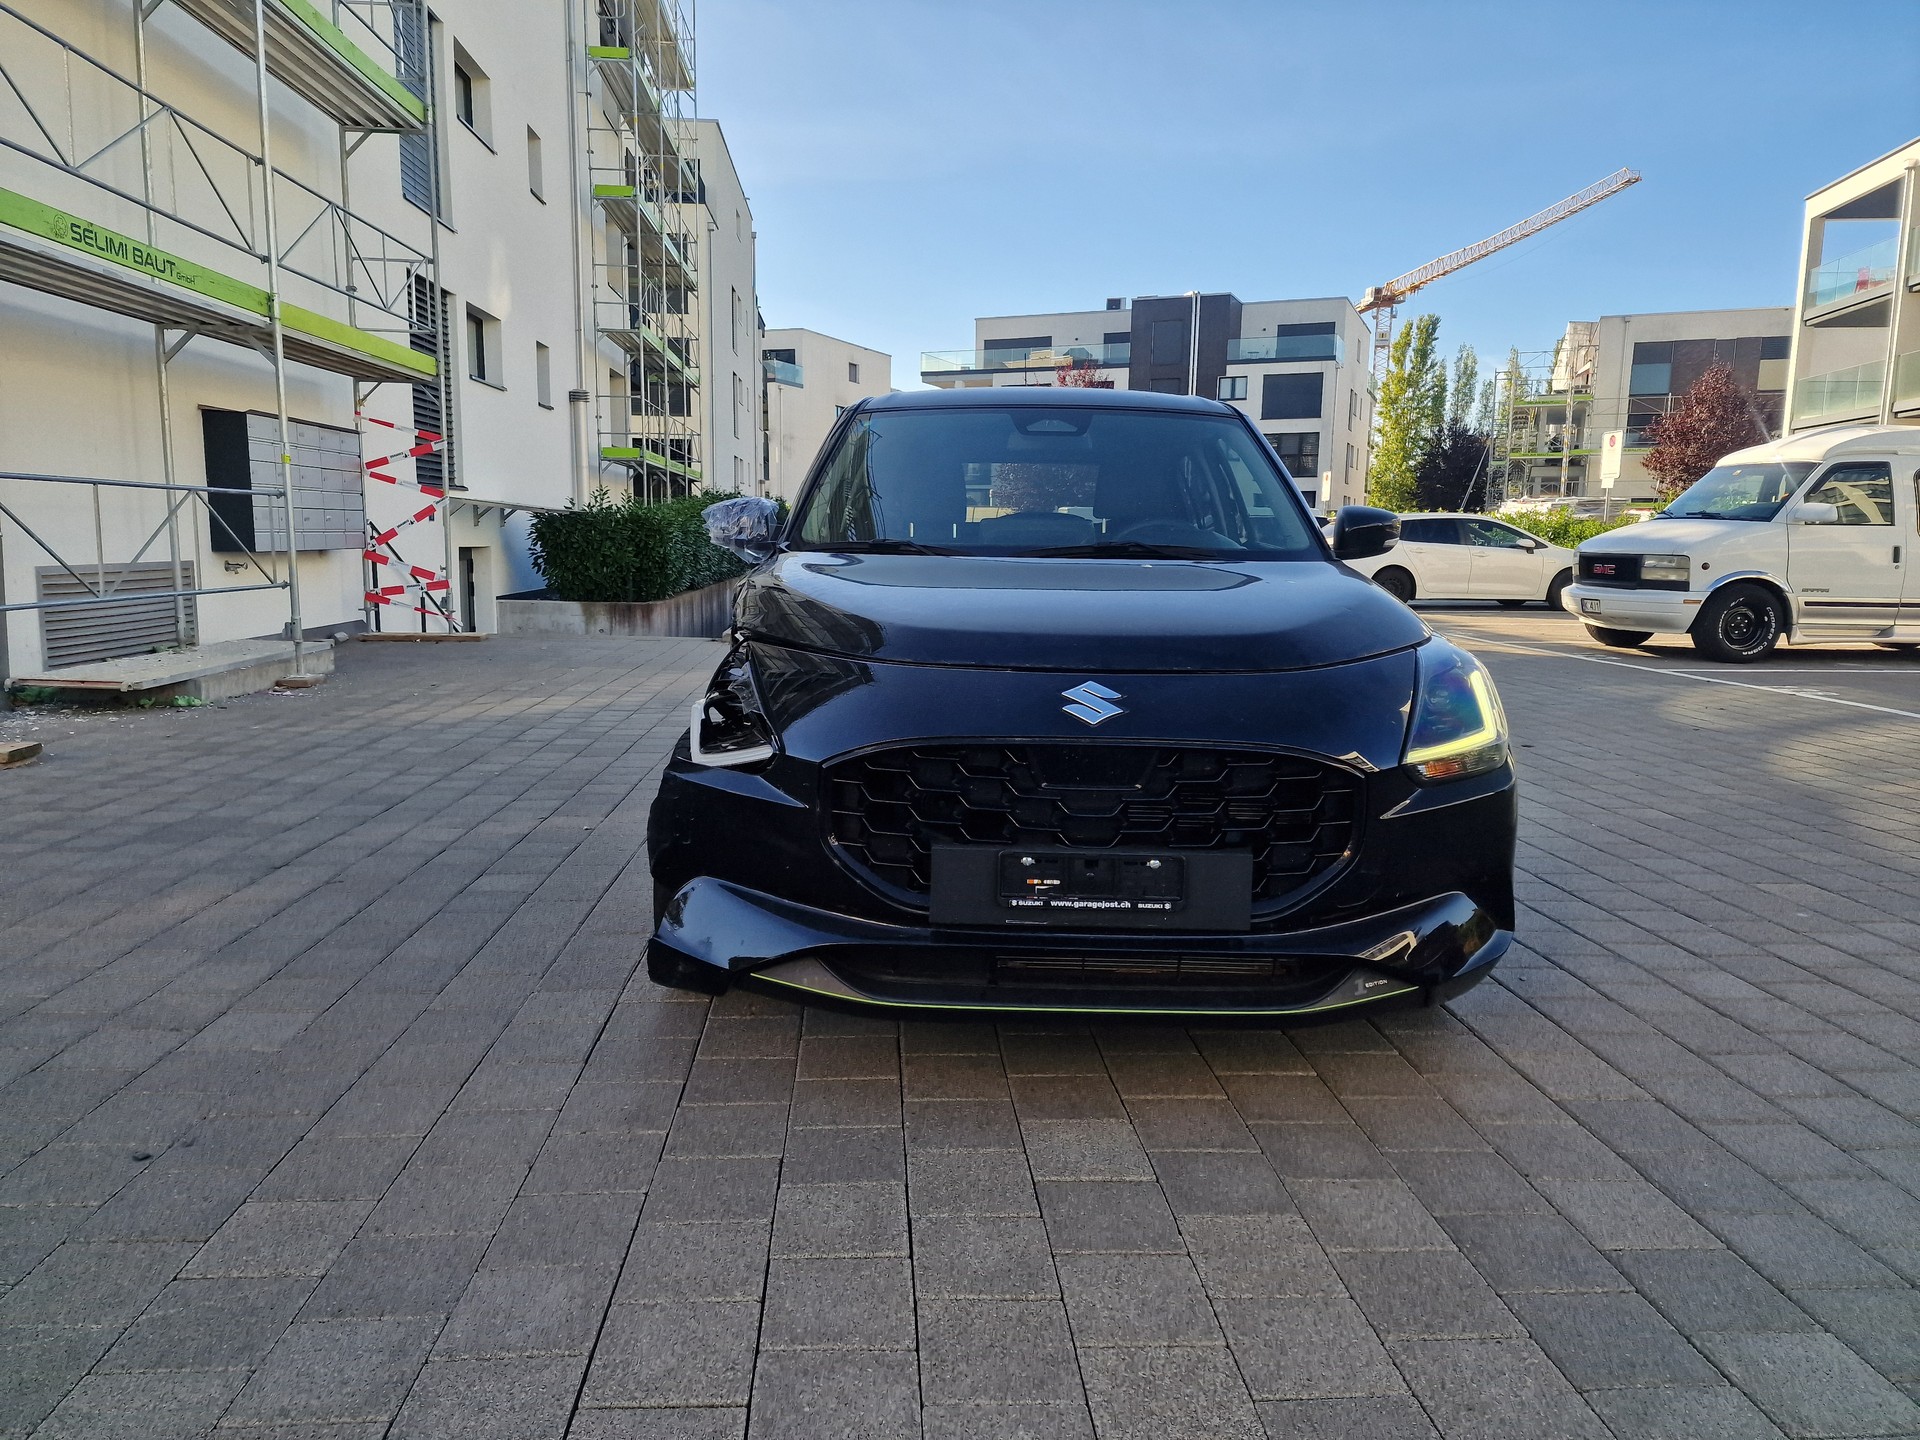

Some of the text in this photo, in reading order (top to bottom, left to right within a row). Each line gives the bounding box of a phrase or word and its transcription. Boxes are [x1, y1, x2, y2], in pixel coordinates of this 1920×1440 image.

[70, 222, 196, 285] SELIMI BAUT GmbH
[1593, 564, 1616, 574] GMC
[1742, 606, 1776, 655] COOPER COBRA
[1050, 901, 1131, 909] www.garagejost.ch
[1365, 979, 1388, 988] EDITION
